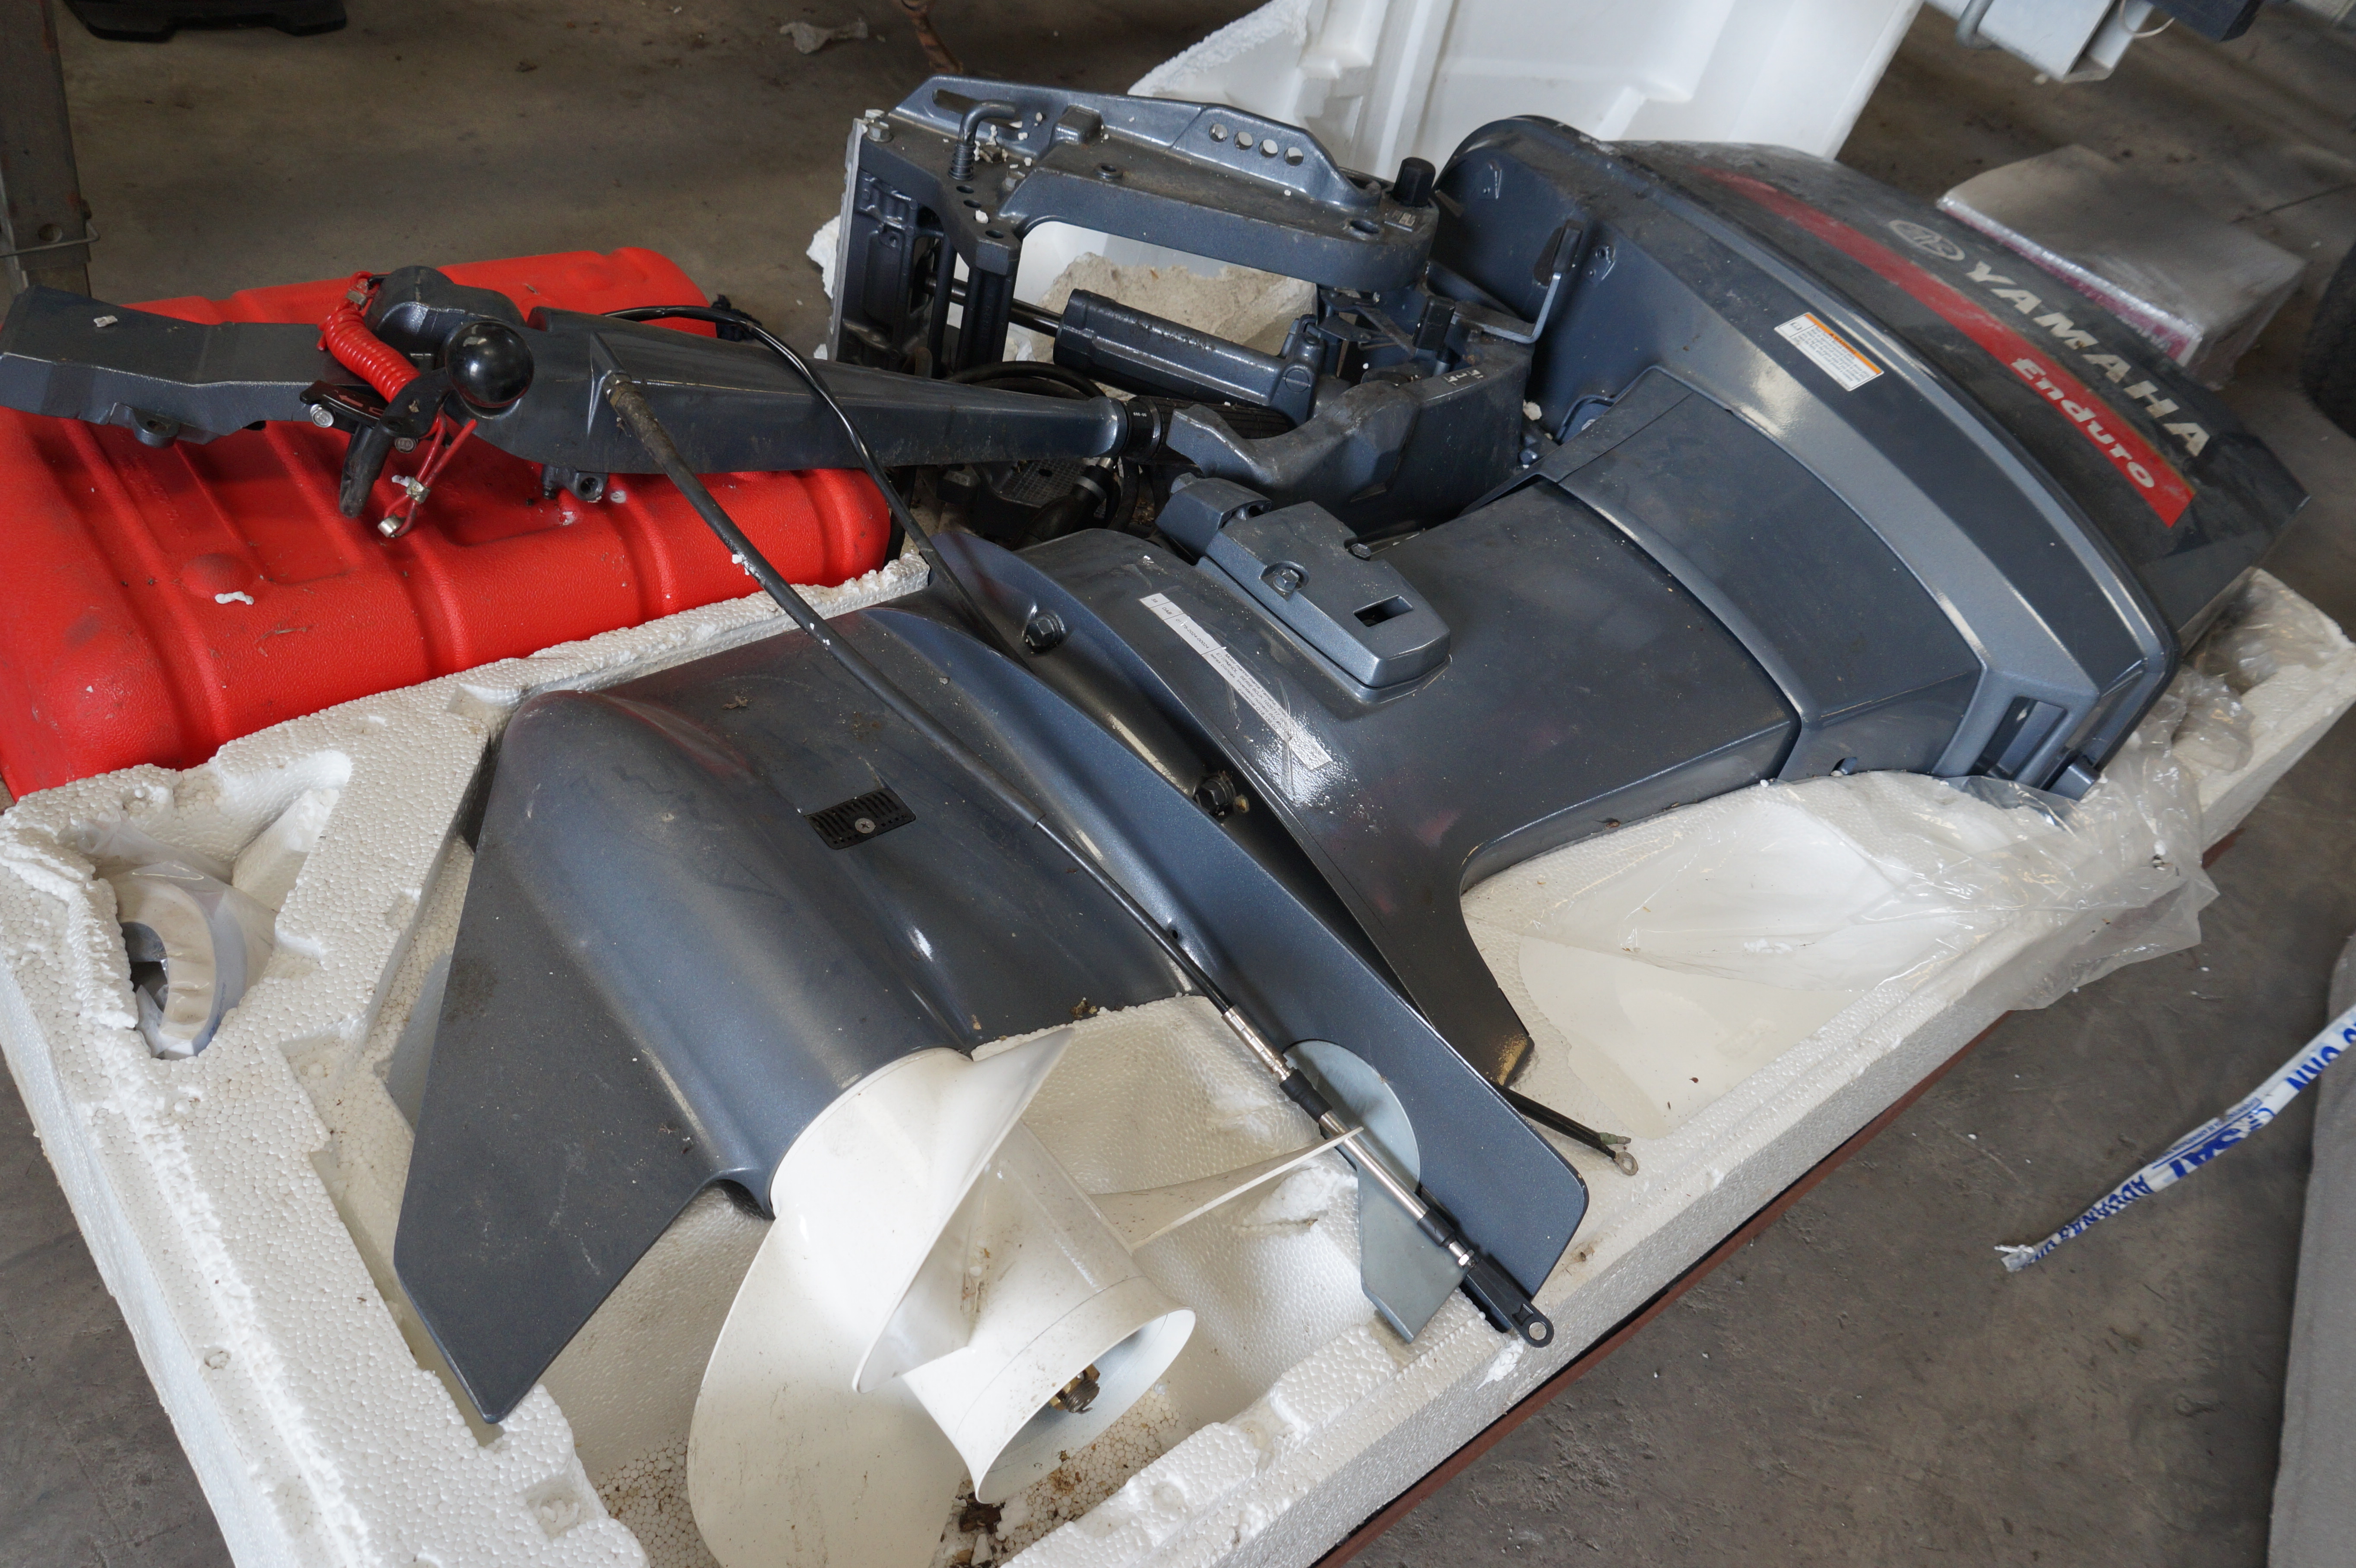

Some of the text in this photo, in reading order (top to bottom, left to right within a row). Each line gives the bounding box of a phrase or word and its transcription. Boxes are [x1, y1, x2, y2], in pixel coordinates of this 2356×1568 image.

[1965, 261, 2211, 457] YAMAHA
[2011, 357, 2155, 489] Enduro
[1210, 653, 1222, 664] letras
[1236, 679, 1255, 698] Inventario
[1224, 654, 1236, 664] Motor
[1235, 664, 1249, 677] marino
[1248, 677, 1261, 689] marca
[1239, 675, 1253, 688] SERIE
[1237, 687, 1257, 707] comercial
